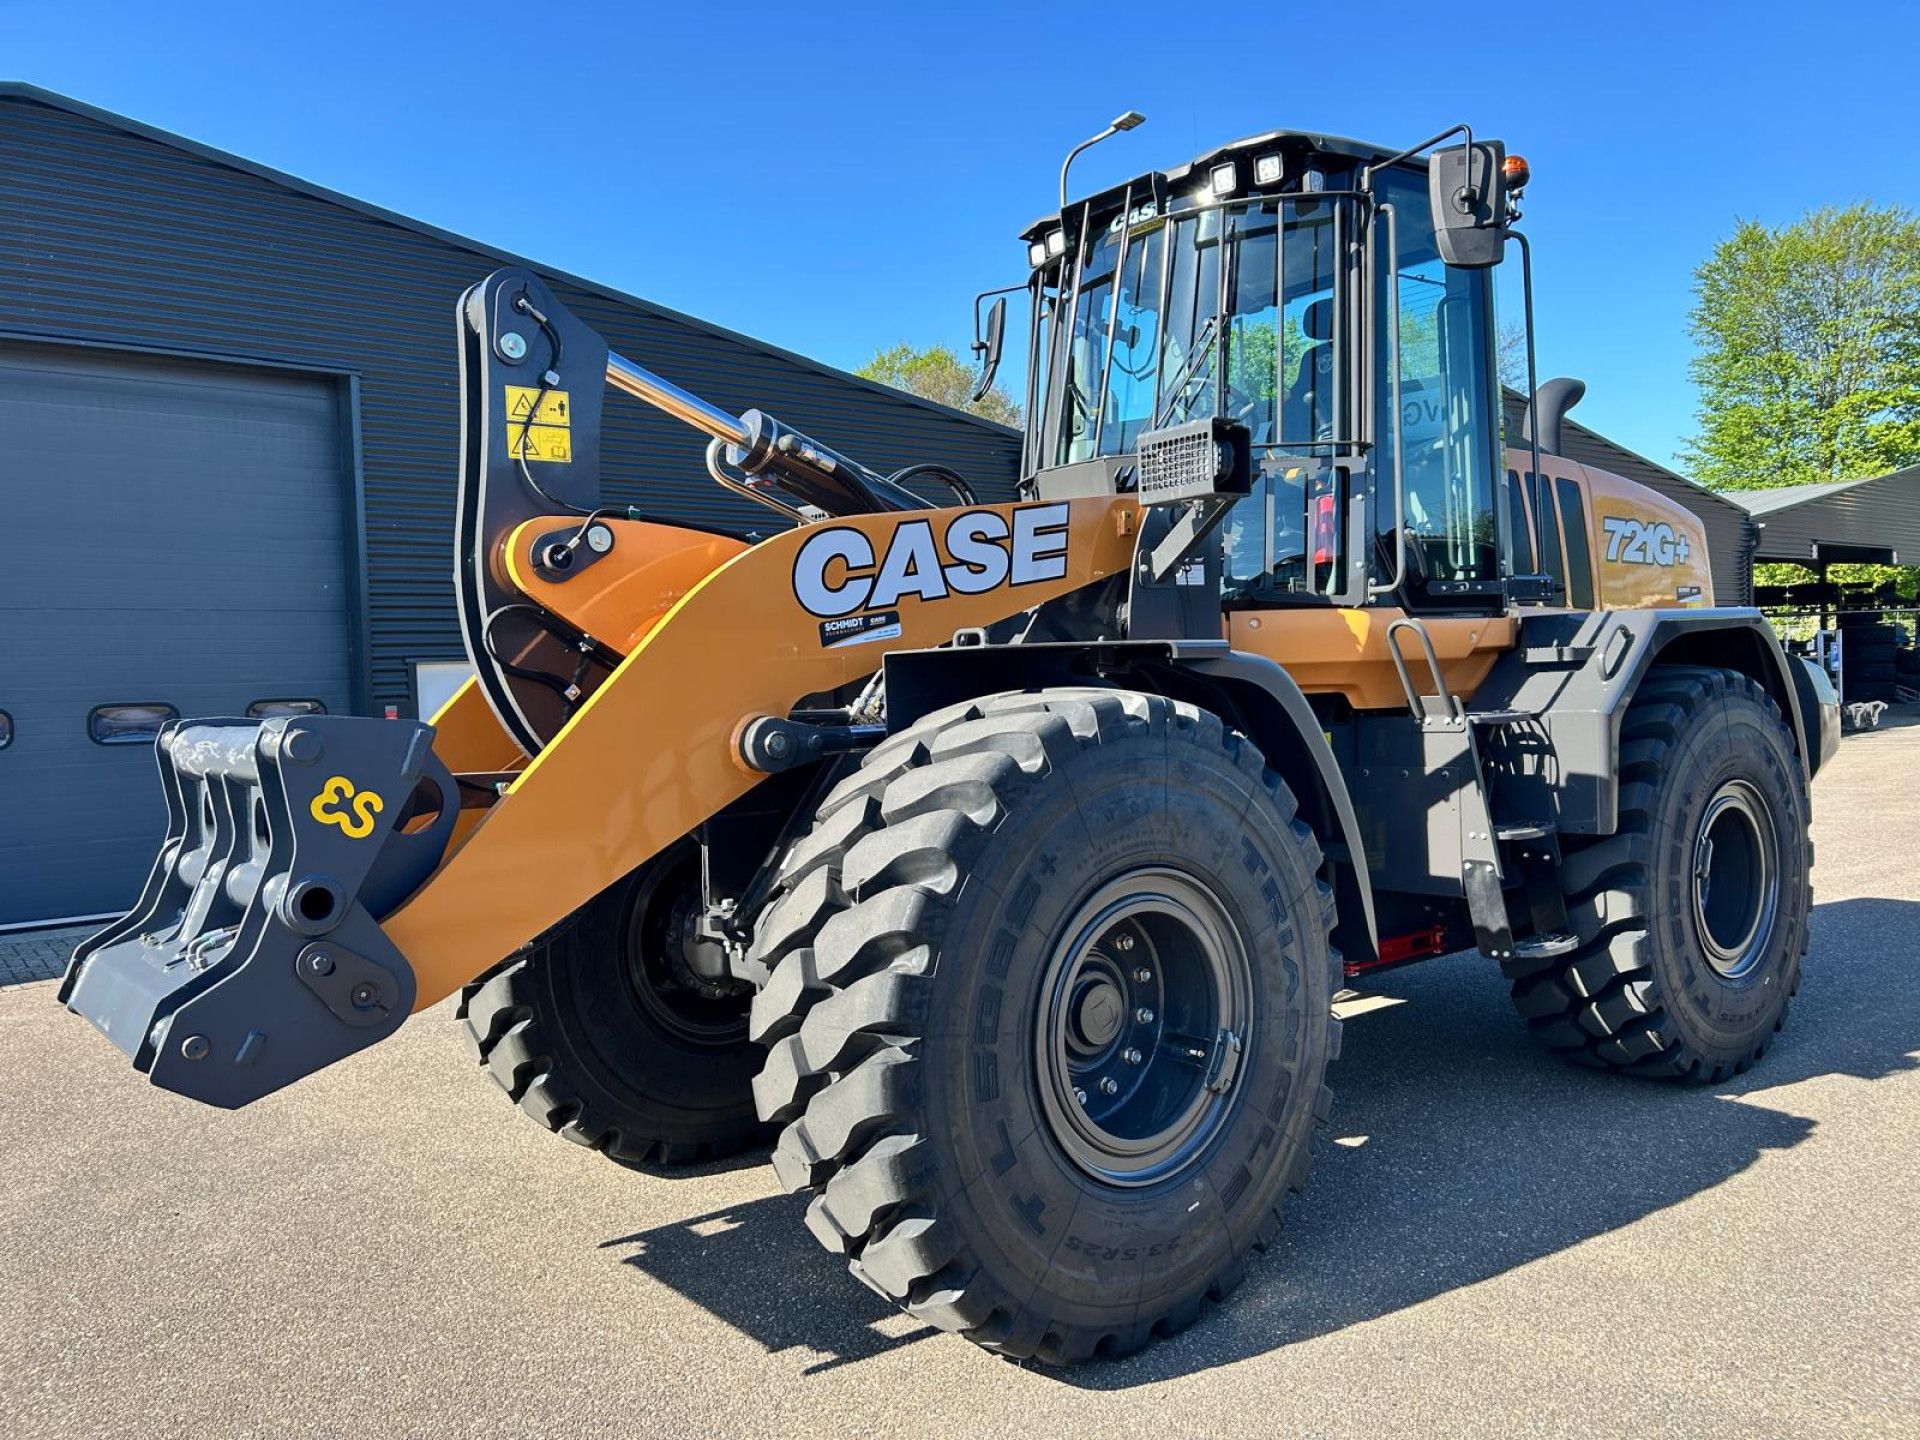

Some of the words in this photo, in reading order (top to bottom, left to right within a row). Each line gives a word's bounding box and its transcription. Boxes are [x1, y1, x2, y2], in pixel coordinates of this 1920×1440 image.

[792, 502, 1070, 618] CASE
[1603, 516, 1690, 567] 721G+
[825, 617, 864, 632] SCHMIDT
